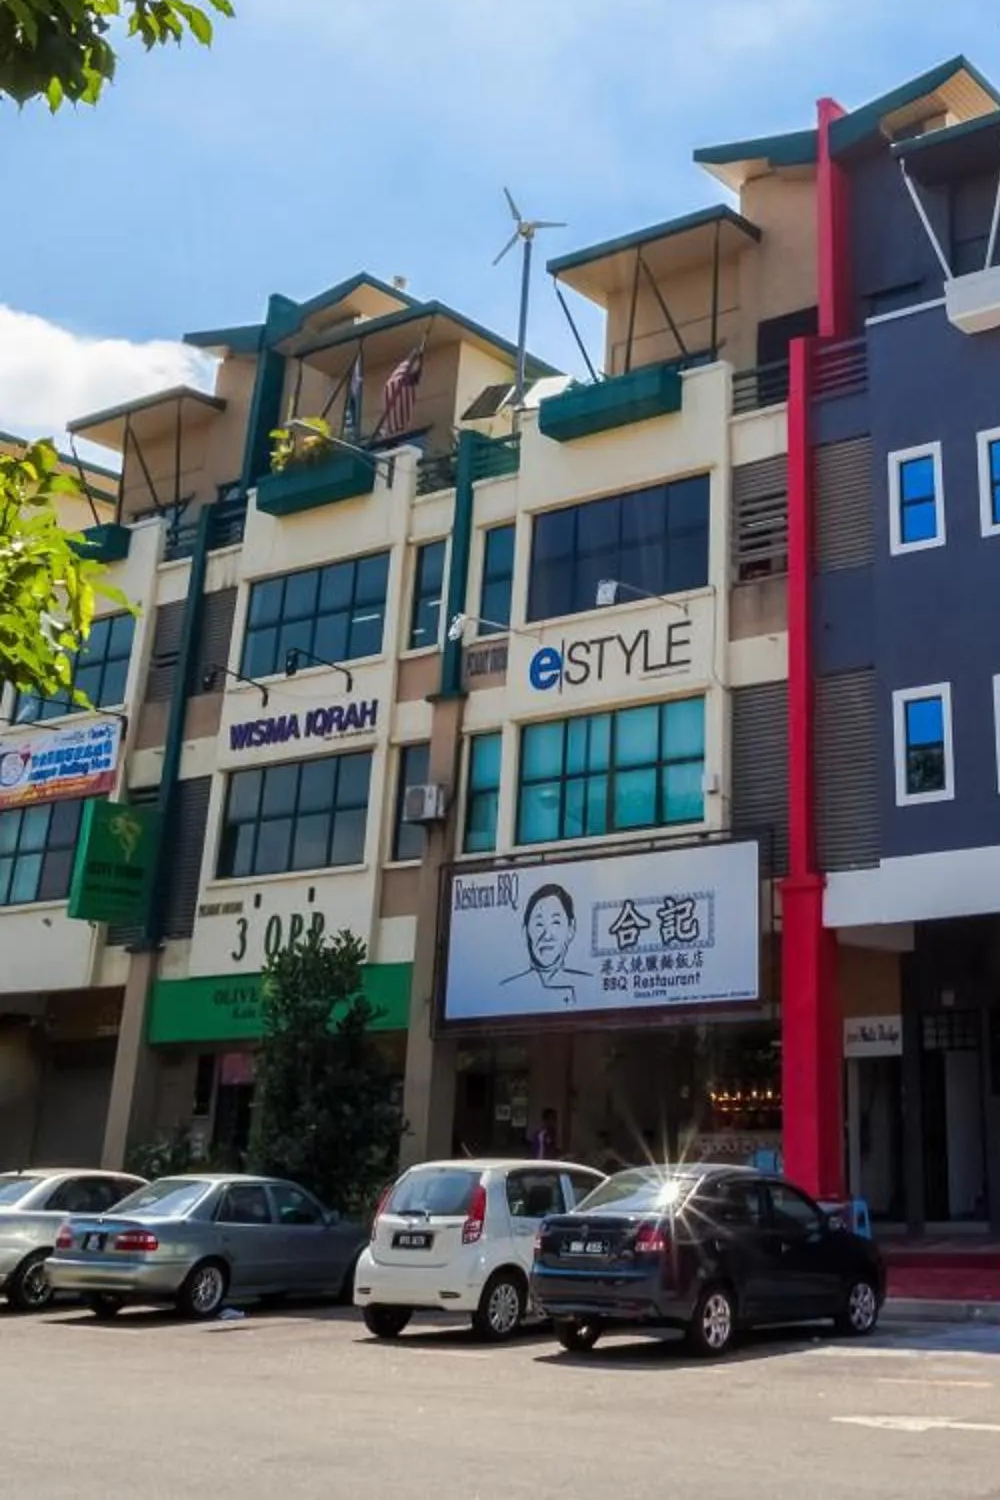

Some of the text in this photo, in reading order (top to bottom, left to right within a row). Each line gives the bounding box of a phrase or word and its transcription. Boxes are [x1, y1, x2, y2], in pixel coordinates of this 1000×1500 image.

[230, 699, 379, 750] WISMA IQRAH
[454, 872, 519, 911] Restoran BBQ
[231, 917, 248, 961] 3
[609, 896, 699, 950] 合記
[603, 972, 701, 992] BBQ Restaurant
